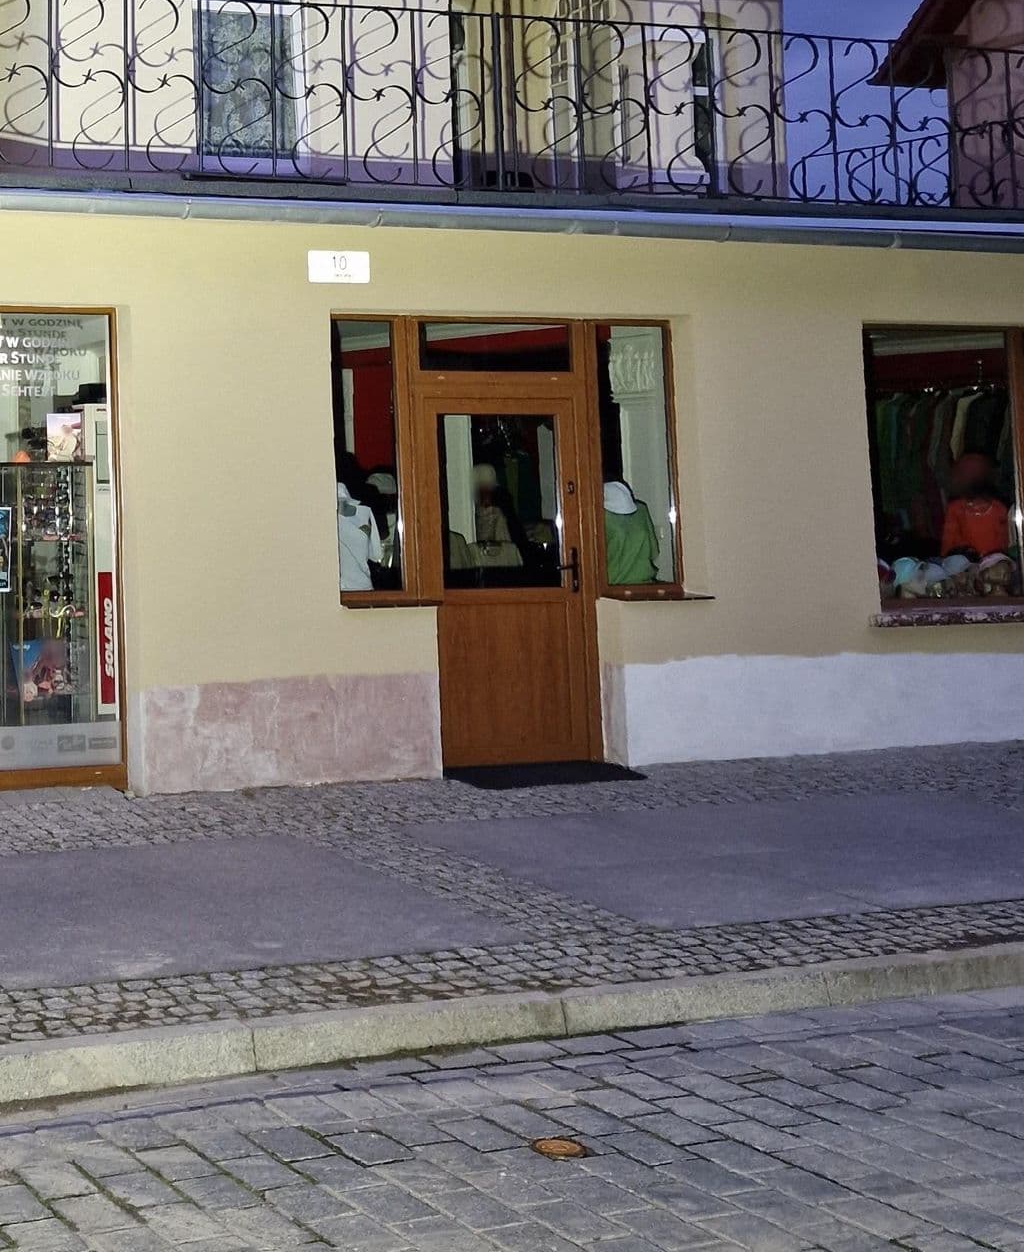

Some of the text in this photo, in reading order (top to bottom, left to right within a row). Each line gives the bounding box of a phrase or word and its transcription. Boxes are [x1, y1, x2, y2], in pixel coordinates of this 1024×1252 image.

[332, 255, 347, 271] 10
[5, 336, 20, 348] W
[22, 336, 76, 349] GODZI
[104, 597, 114, 679] SOLANO
